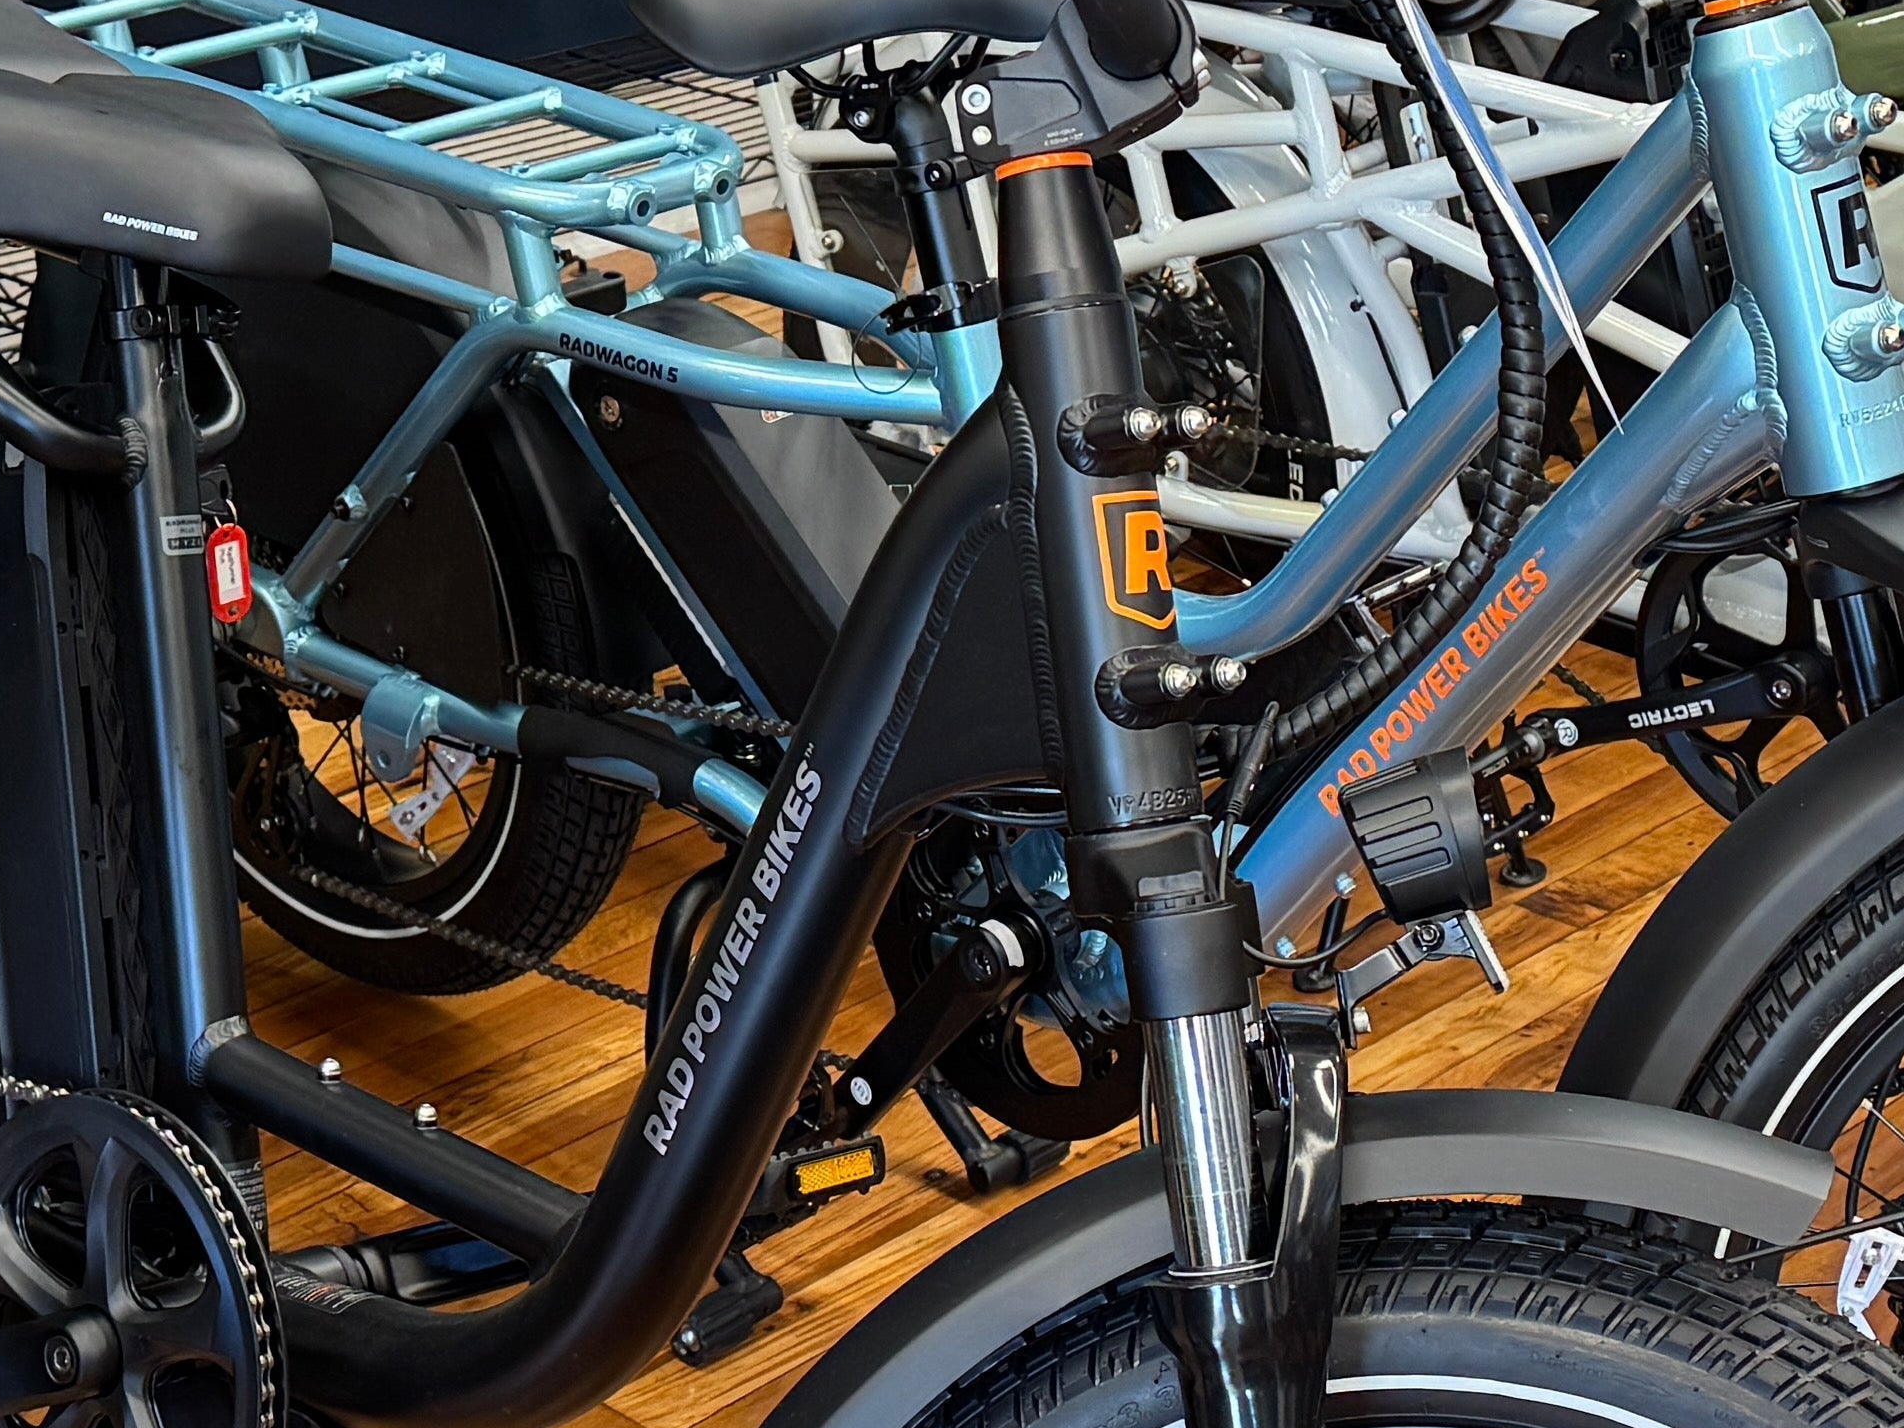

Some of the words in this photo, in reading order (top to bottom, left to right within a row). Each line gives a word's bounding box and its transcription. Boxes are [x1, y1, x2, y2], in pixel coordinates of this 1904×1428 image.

[103, 211, 127, 226] RAD
[126, 217, 165, 234] POWER
[164, 226, 199, 241] BIKES
[558, 329, 662, 382] RADWAGON
[665, 362, 679, 385] 5
[1124, 509, 1173, 596] R
[1368, 651, 1472, 767] POWER
[1628, 698, 1716, 730] LECTRIC
[643, 1054, 698, 1157] RAD
[688, 888, 768, 1064] POWER
